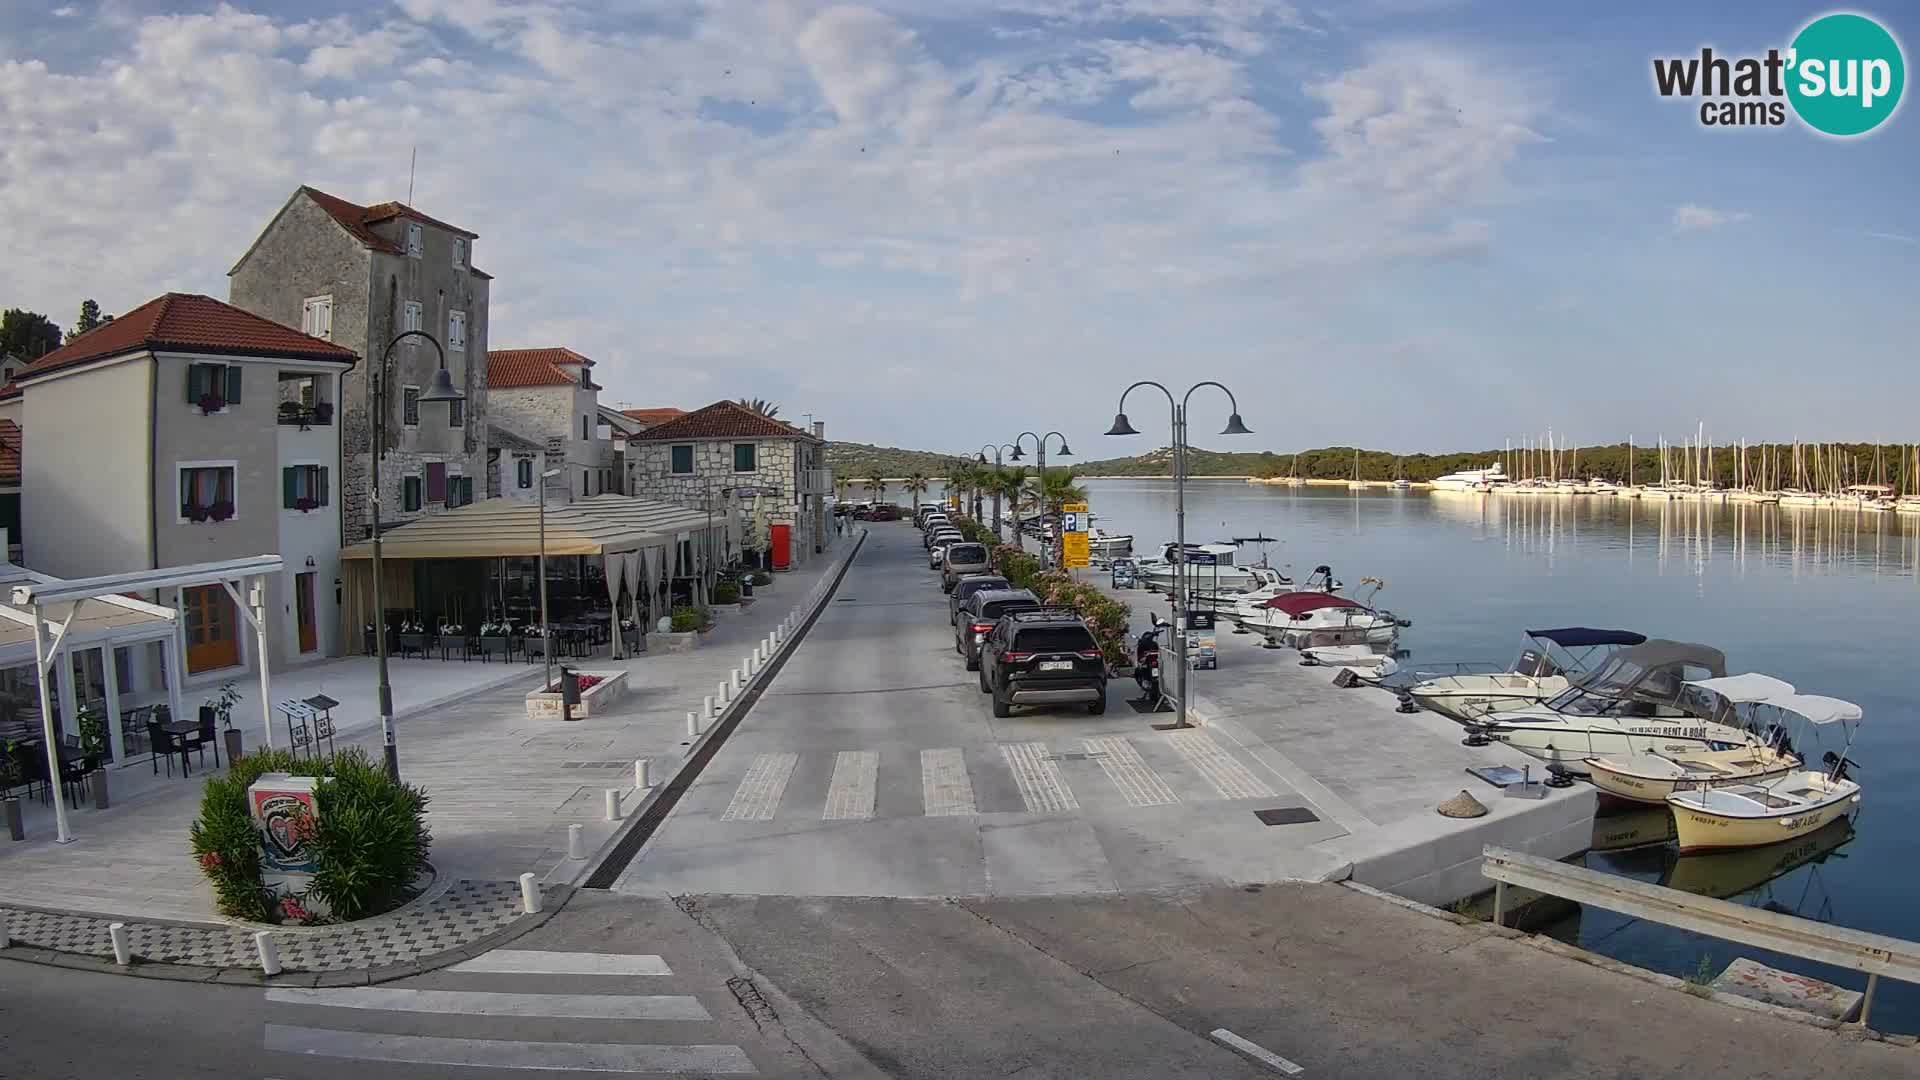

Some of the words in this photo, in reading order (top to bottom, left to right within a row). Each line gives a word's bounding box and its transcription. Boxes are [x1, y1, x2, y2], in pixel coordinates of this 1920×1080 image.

[1662, 726, 1681, 736] RENT
[1682, 727, 1688, 737] A
[1688, 727, 1707, 739] BOAT
